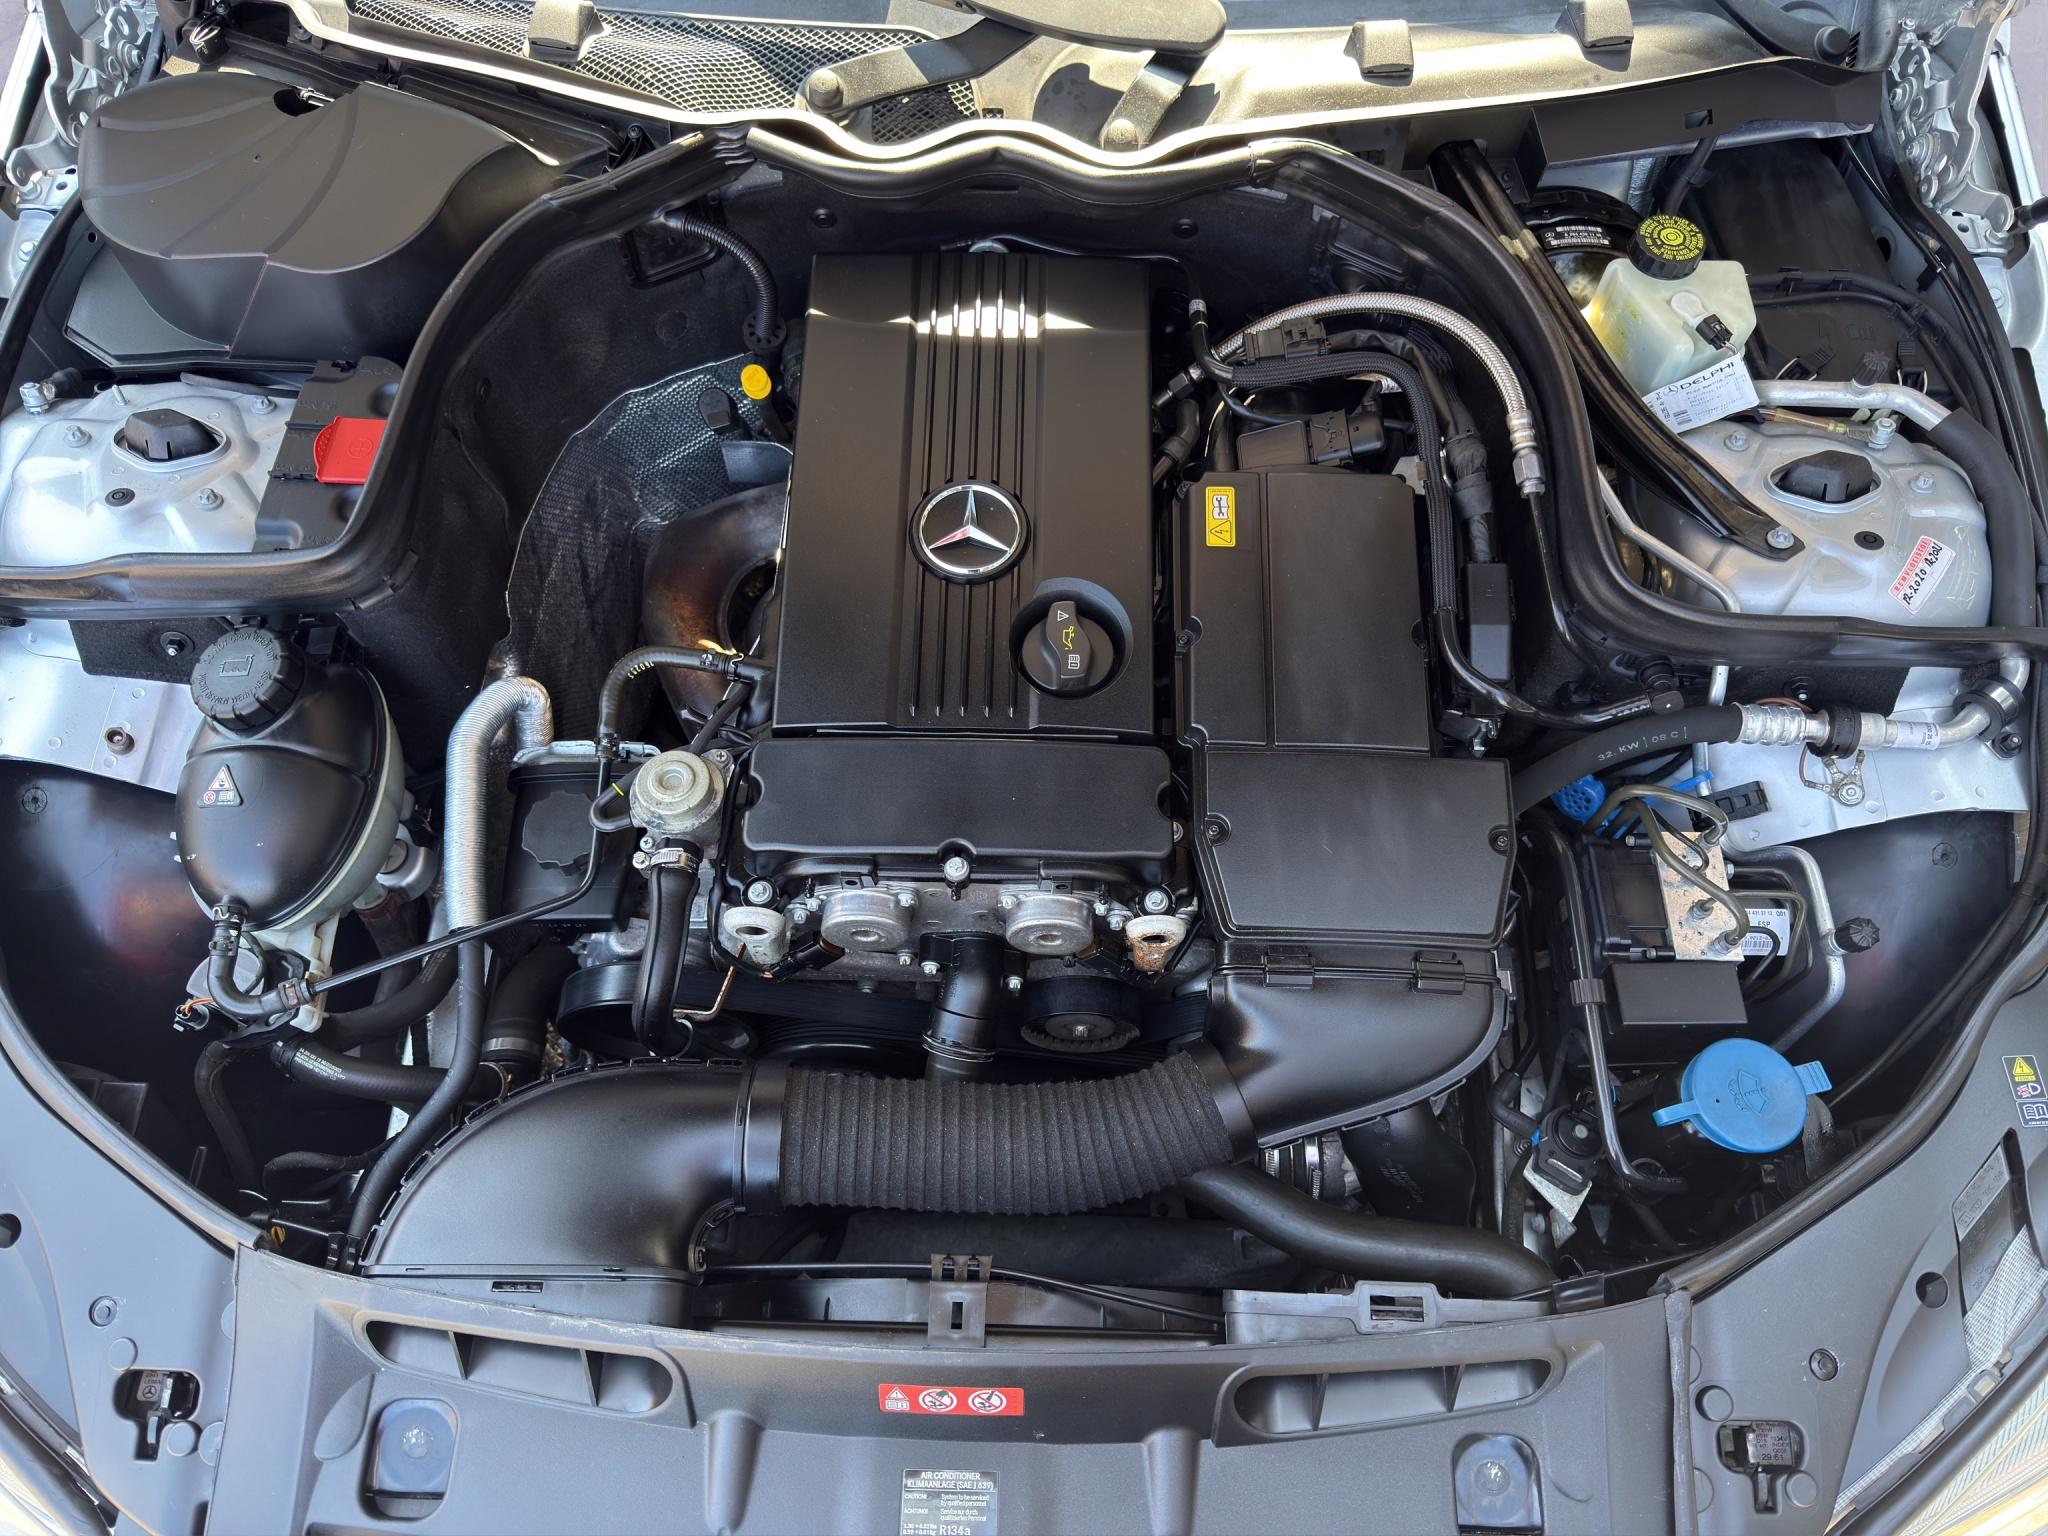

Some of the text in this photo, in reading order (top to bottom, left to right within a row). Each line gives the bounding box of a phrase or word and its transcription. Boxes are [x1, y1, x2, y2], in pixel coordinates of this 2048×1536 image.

[1680, 361, 1735, 390] DELPHI
[1619, 741, 1639, 753] KW
[921, 1471, 981, 1481] AIR CONDITIONER
[907, 1480, 956, 1489] KLIMAANLAGE
[956, 1481, 973, 1491] (SAE
[978, 1482, 994, 1491] 639)
[940, 1525, 971, 1536] R134a
